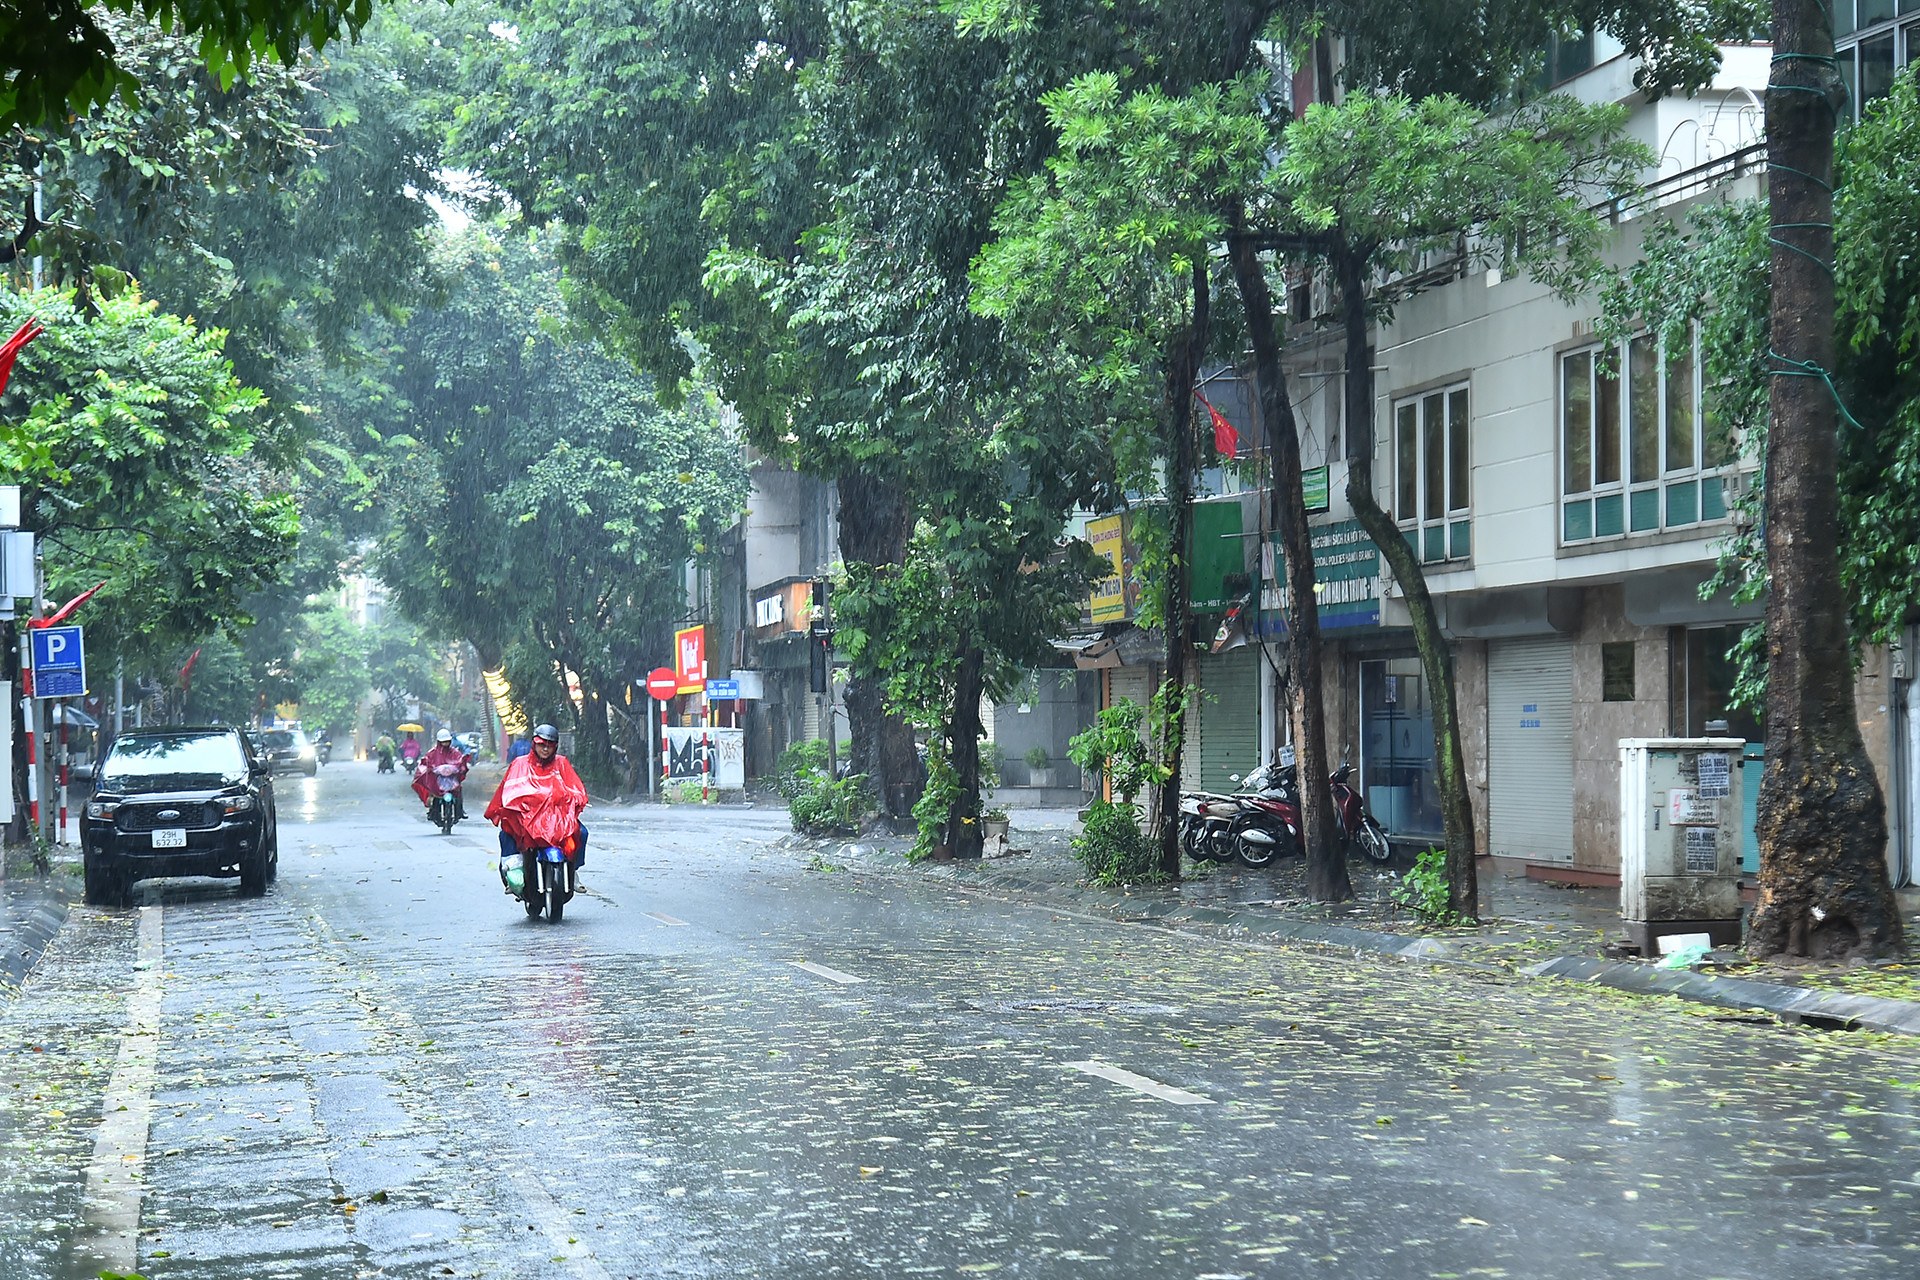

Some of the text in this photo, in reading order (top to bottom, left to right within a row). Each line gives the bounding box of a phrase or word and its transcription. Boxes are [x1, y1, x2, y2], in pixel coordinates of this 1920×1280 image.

[1314, 556, 1328, 568] SOCIAL
[1328, 553, 1345, 566] POLICIES
[1359, 549, 1375, 562] BRANCH
[47, 634, 66, 662] P
[161, 831, 177, 839] 29H
